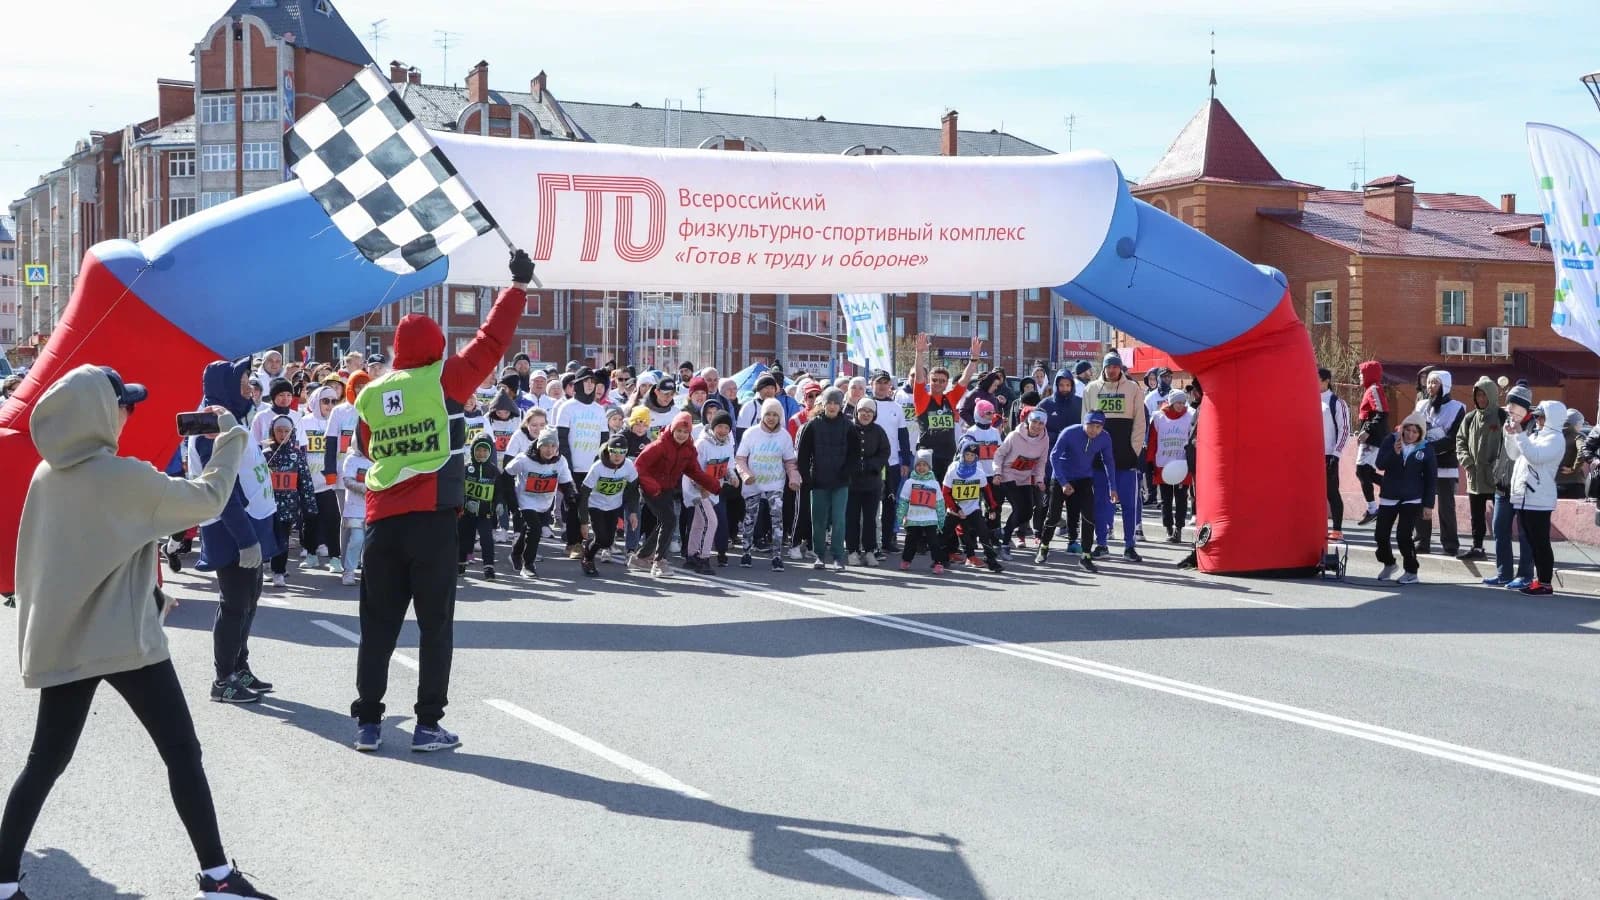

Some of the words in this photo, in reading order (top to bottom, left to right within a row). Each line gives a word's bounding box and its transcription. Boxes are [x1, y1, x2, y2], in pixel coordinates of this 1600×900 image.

[678, 188, 826, 212] Всероссийский
[534, 173, 667, 262] ГТО
[678, 217, 933, 245] физкультурно-спортивный
[940, 226, 1026, 242] комплекс
[675, 246, 741, 265] «Готов
[747, 254, 757, 265] к
[763, 253, 817, 270] труду
[821, 255, 833, 266] и
[839, 250, 929, 270] обороне»
[1100, 399, 1122, 411] 256
[373, 417, 436, 443] ЛАВНЫЙ
[931, 416, 952, 428] 345
[275, 474, 290, 488] 10
[534, 479, 550, 491] 67
[600, 482, 623, 494] 229
[467, 482, 490, 500] 201
[956, 485, 977, 499] 147
